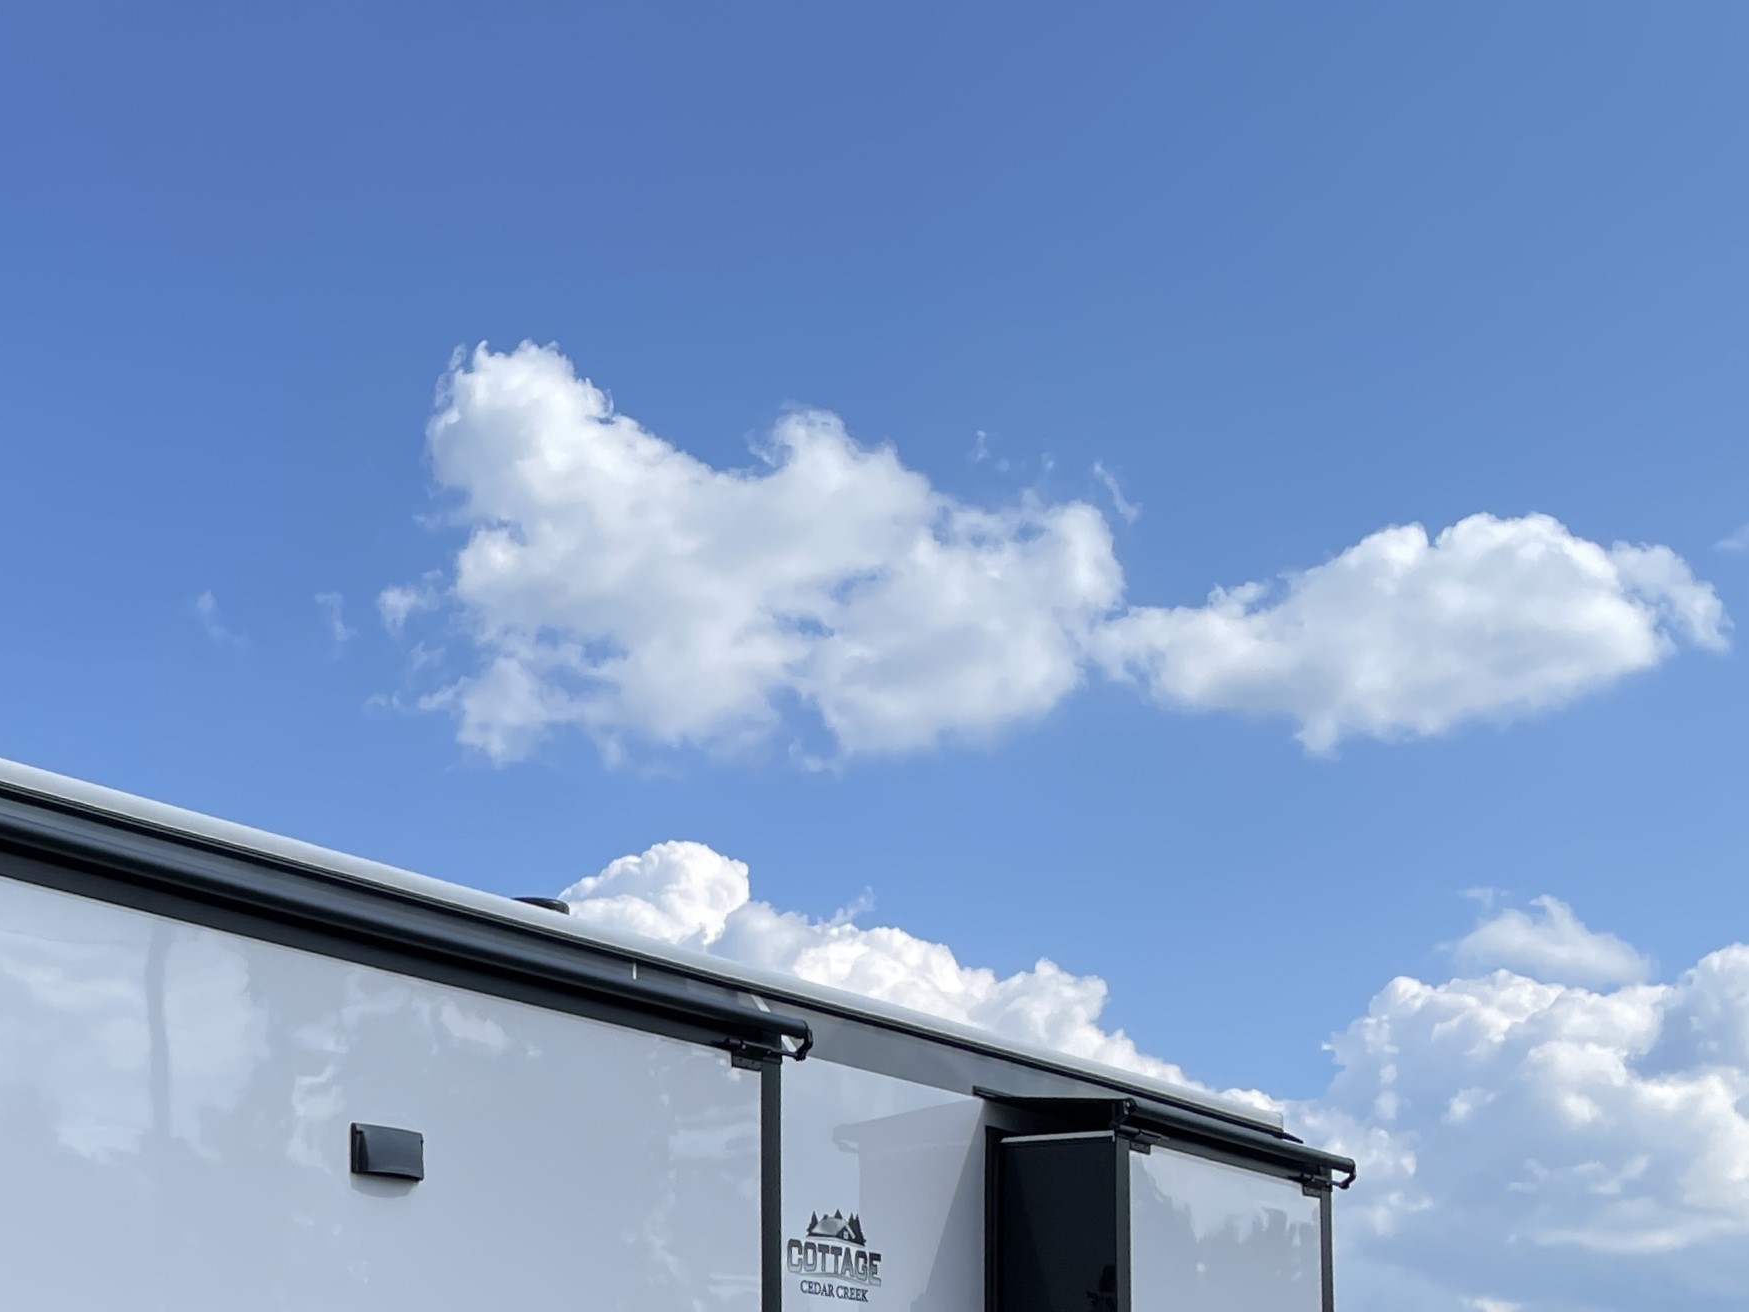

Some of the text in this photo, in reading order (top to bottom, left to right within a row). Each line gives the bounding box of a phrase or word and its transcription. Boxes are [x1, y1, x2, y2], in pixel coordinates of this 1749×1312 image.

[787, 1239, 882, 1286] COTTAGE
[800, 1280, 869, 1302] CEDAR CREEK
